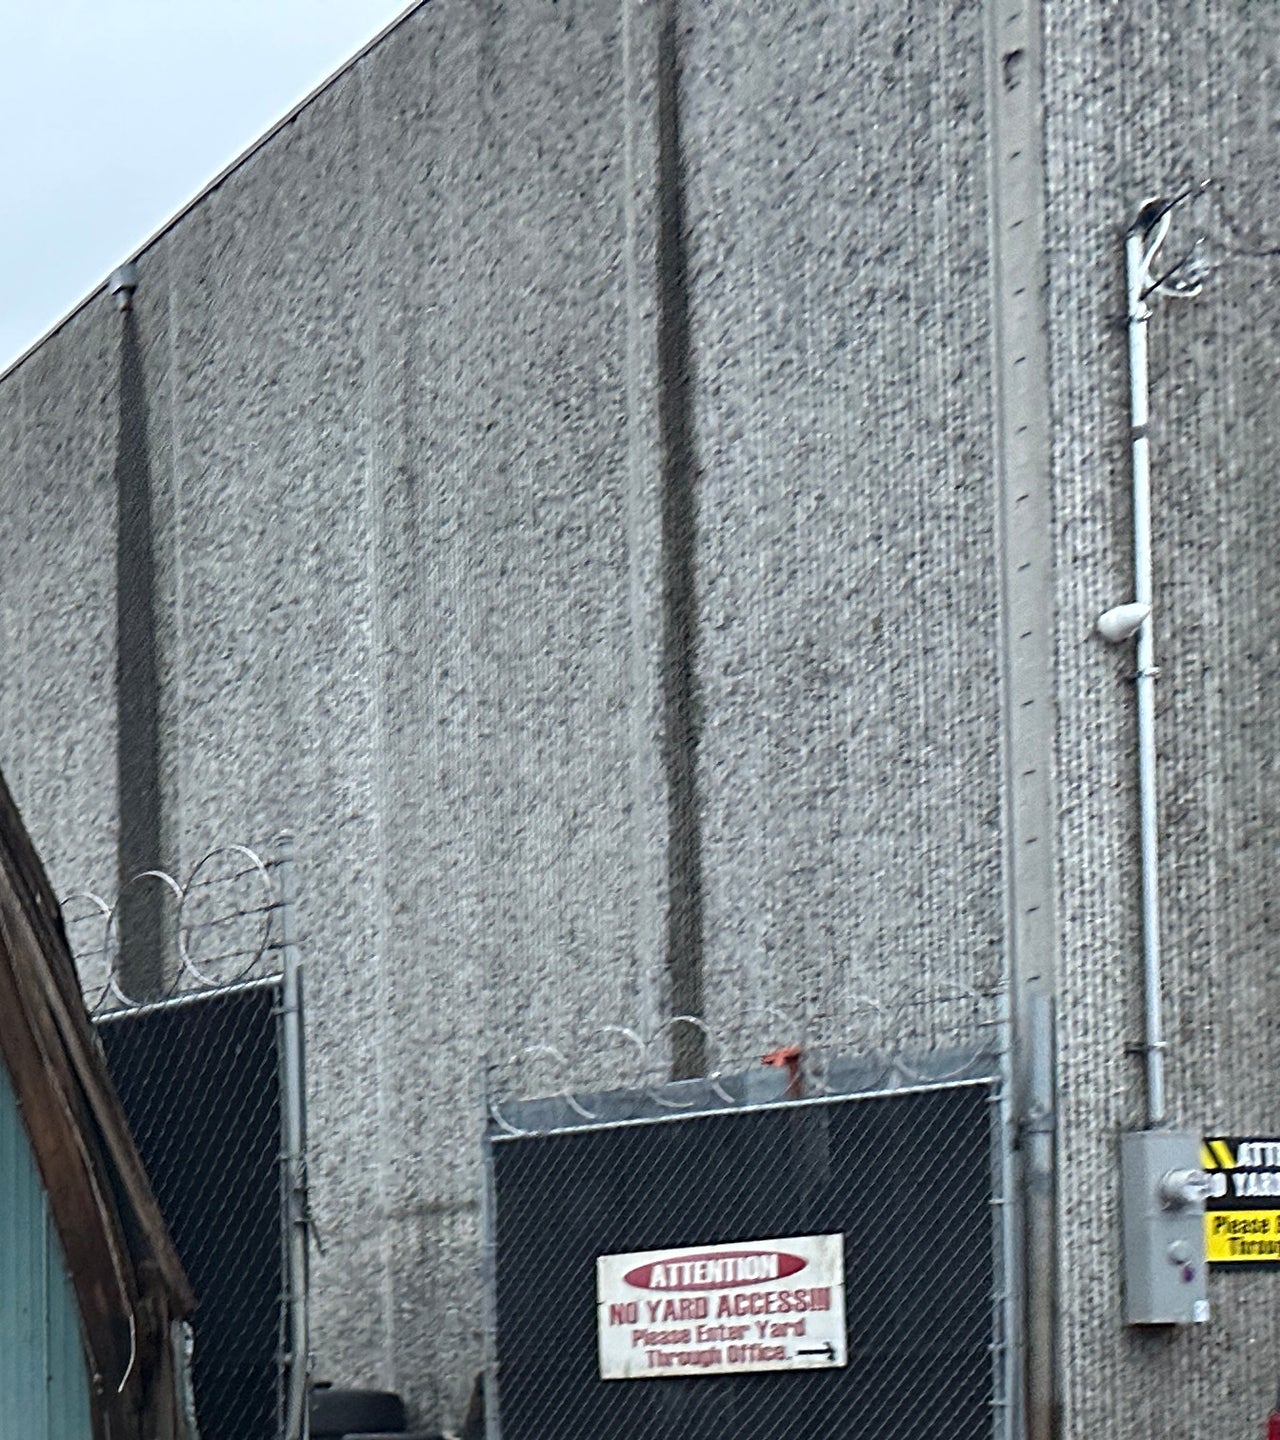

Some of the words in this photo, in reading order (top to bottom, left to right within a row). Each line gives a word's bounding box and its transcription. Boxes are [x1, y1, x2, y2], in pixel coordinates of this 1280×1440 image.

[1236, 1142, 1280, 1167] ATT
[649, 1254, 779, 1287] ATTENTION
[609, 1301, 638, 1326] NO
[646, 1296, 709, 1323] YARD
[631, 1328, 691, 1347] Please
[696, 1323, 750, 1343] Enter
[755, 1318, 806, 1339] Yard
[645, 1348, 722, 1368] Through
